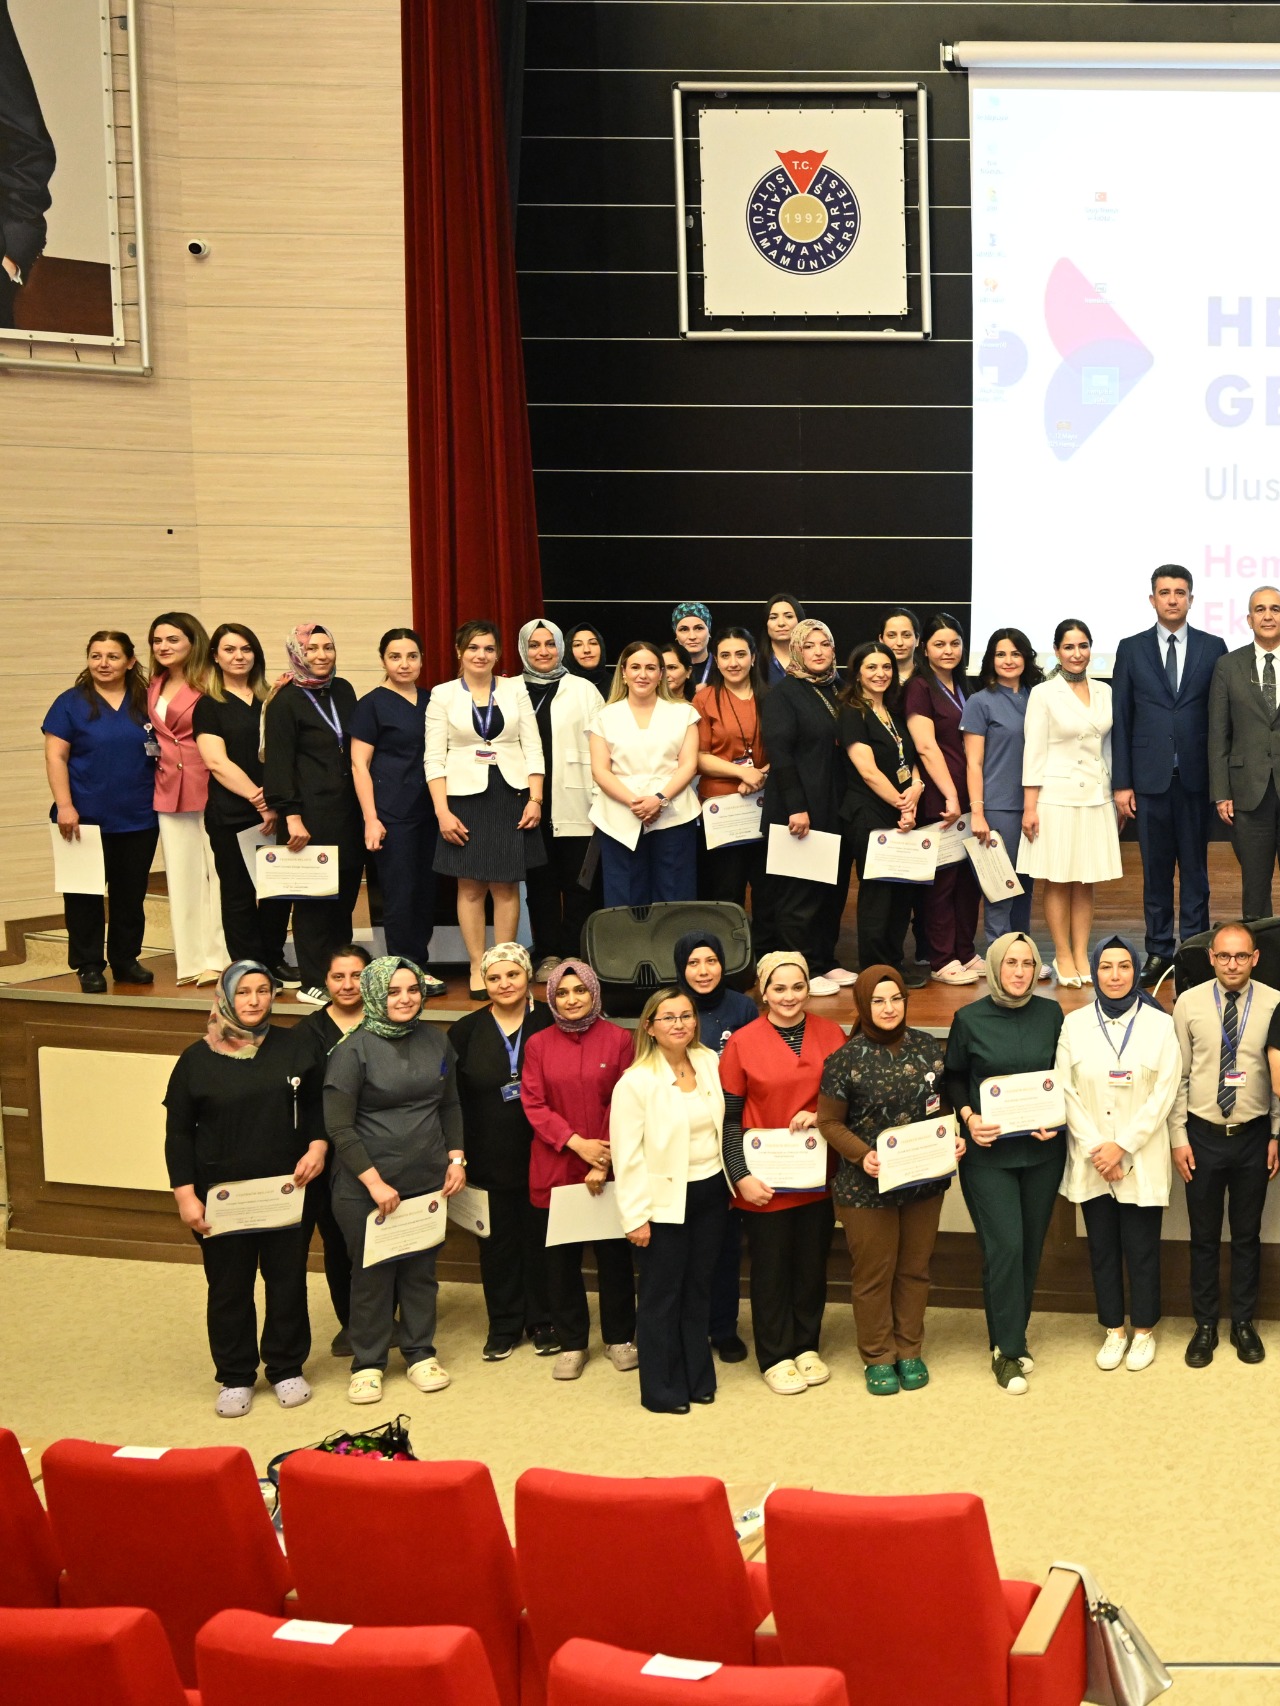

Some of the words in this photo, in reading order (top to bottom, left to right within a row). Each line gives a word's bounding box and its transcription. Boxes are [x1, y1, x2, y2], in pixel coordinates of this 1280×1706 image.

[792, 161, 813, 170] T.C.
[752, 173, 785, 224] SÜTÇÜ
[784, 213, 823, 224] 1992
